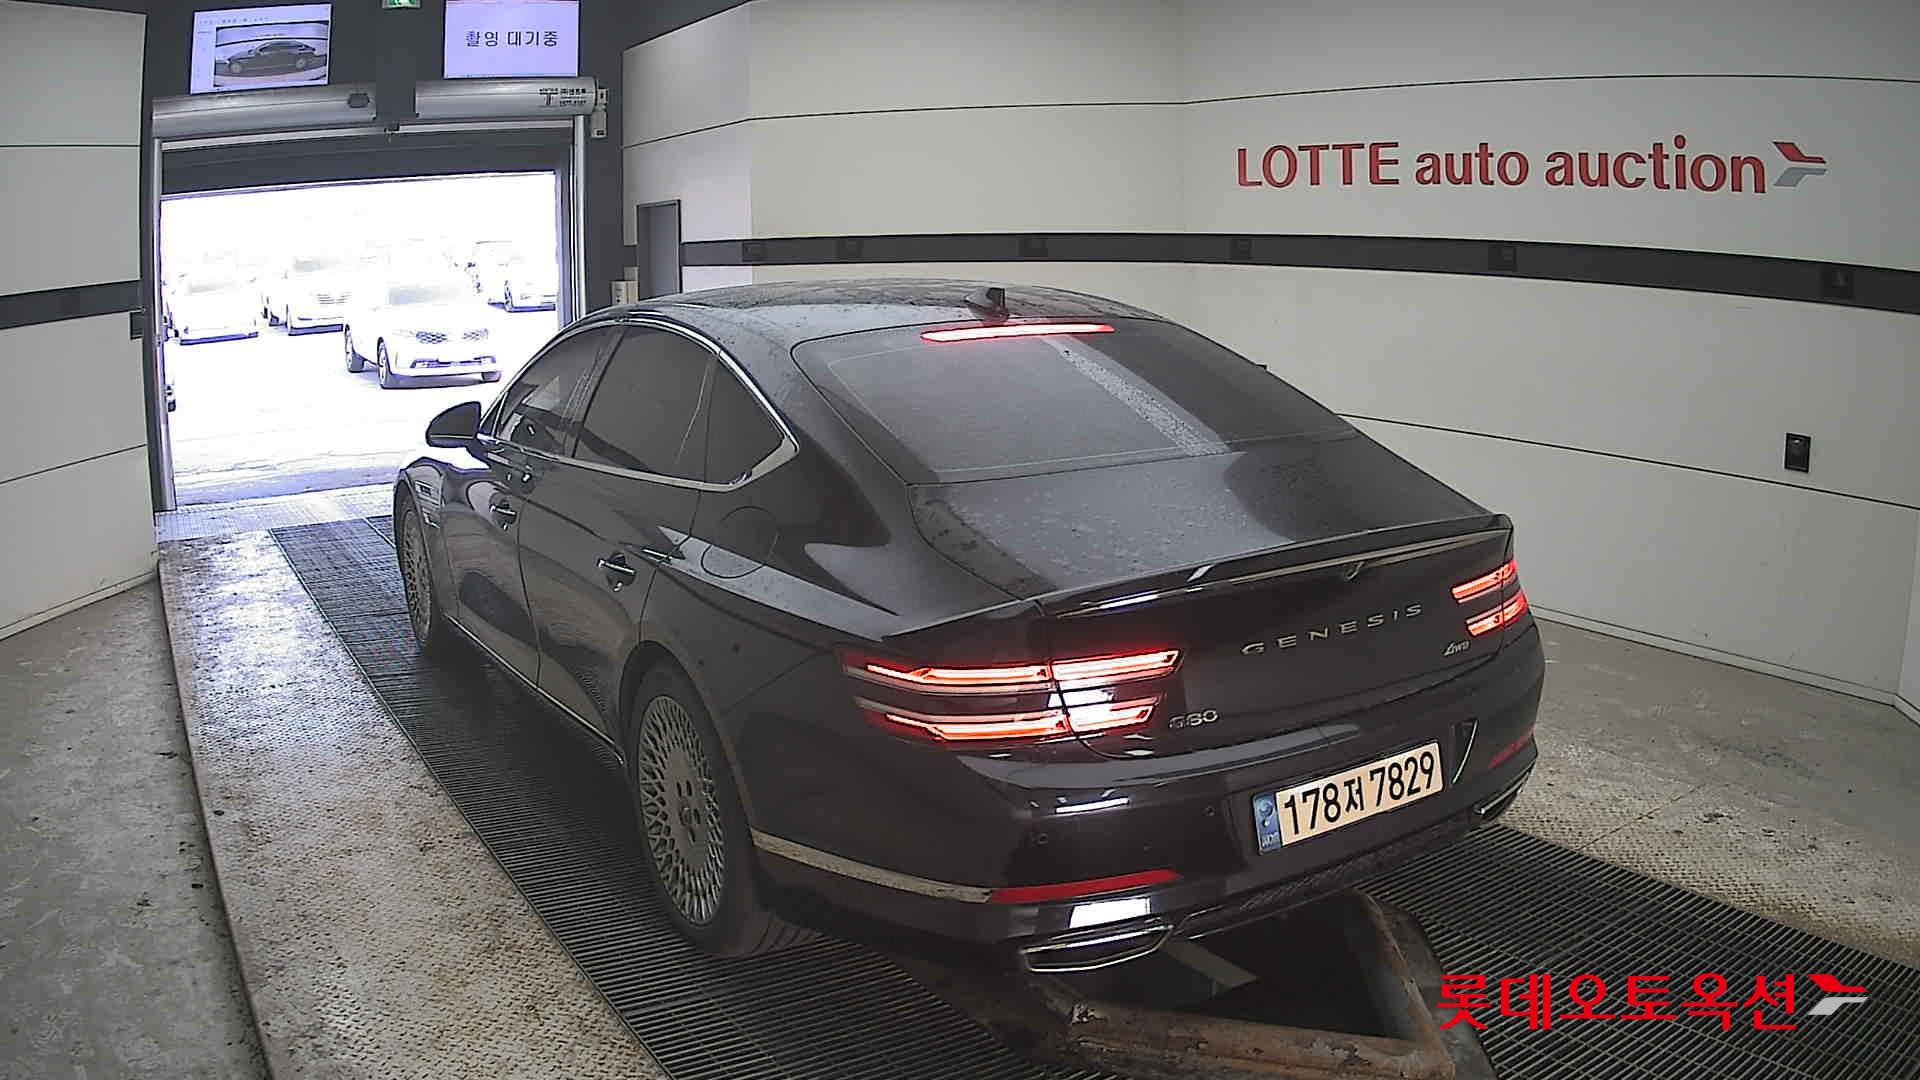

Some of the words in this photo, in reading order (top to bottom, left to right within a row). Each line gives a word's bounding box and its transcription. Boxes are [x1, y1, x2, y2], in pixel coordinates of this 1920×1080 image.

[507, 30, 559, 48] 대기중
[1237, 143, 1400, 187] LOTTE
[1415, 143, 1530, 186] auto
[1544, 136, 1767, 194] auction
[1241, 603, 1423, 655] GENESIS
[1284, 777, 1365, 836] 178저
[1369, 751, 1435, 807] 7829
